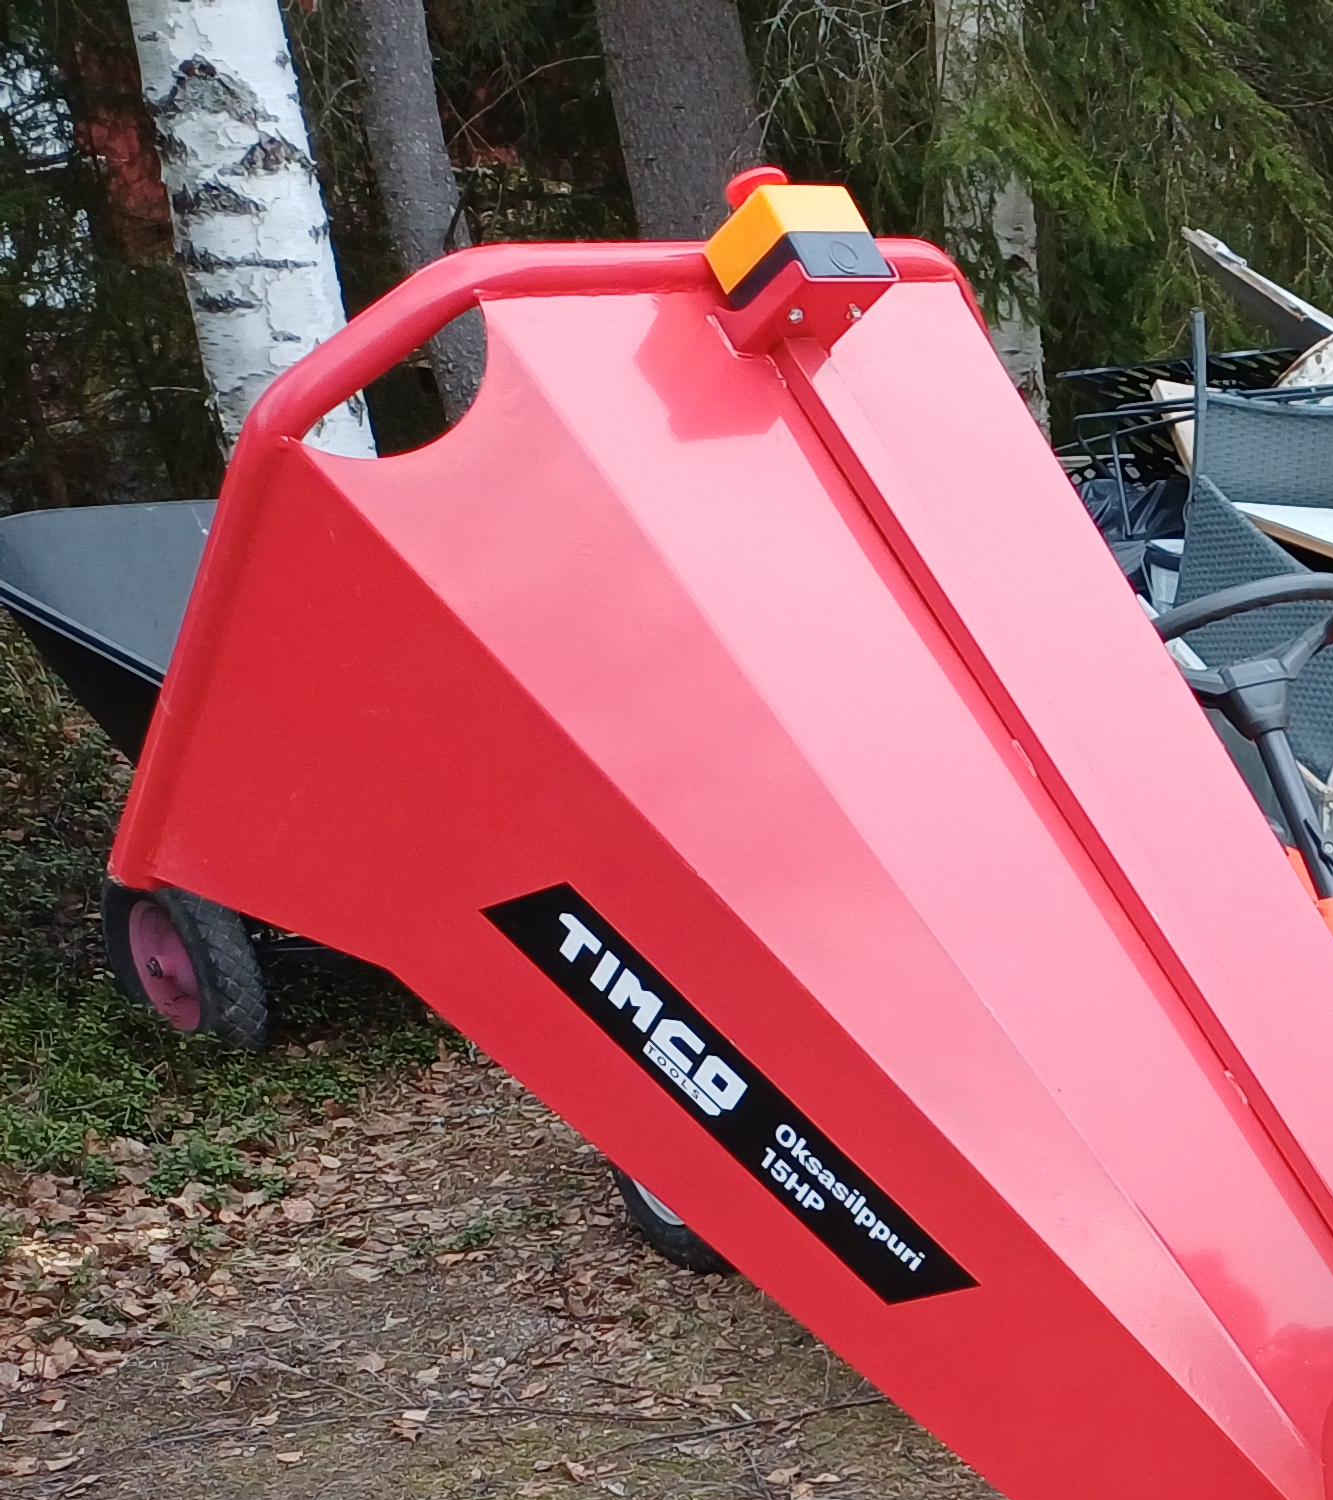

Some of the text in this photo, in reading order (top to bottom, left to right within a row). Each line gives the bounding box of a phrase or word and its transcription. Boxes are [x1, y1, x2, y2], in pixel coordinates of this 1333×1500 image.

[559, 913, 748, 1112] TIMCO
[646, 1043, 701, 1100] TOOLS
[760, 1147, 825, 1212] 15HP
[775, 1124, 926, 1271] Oksasilppuri
